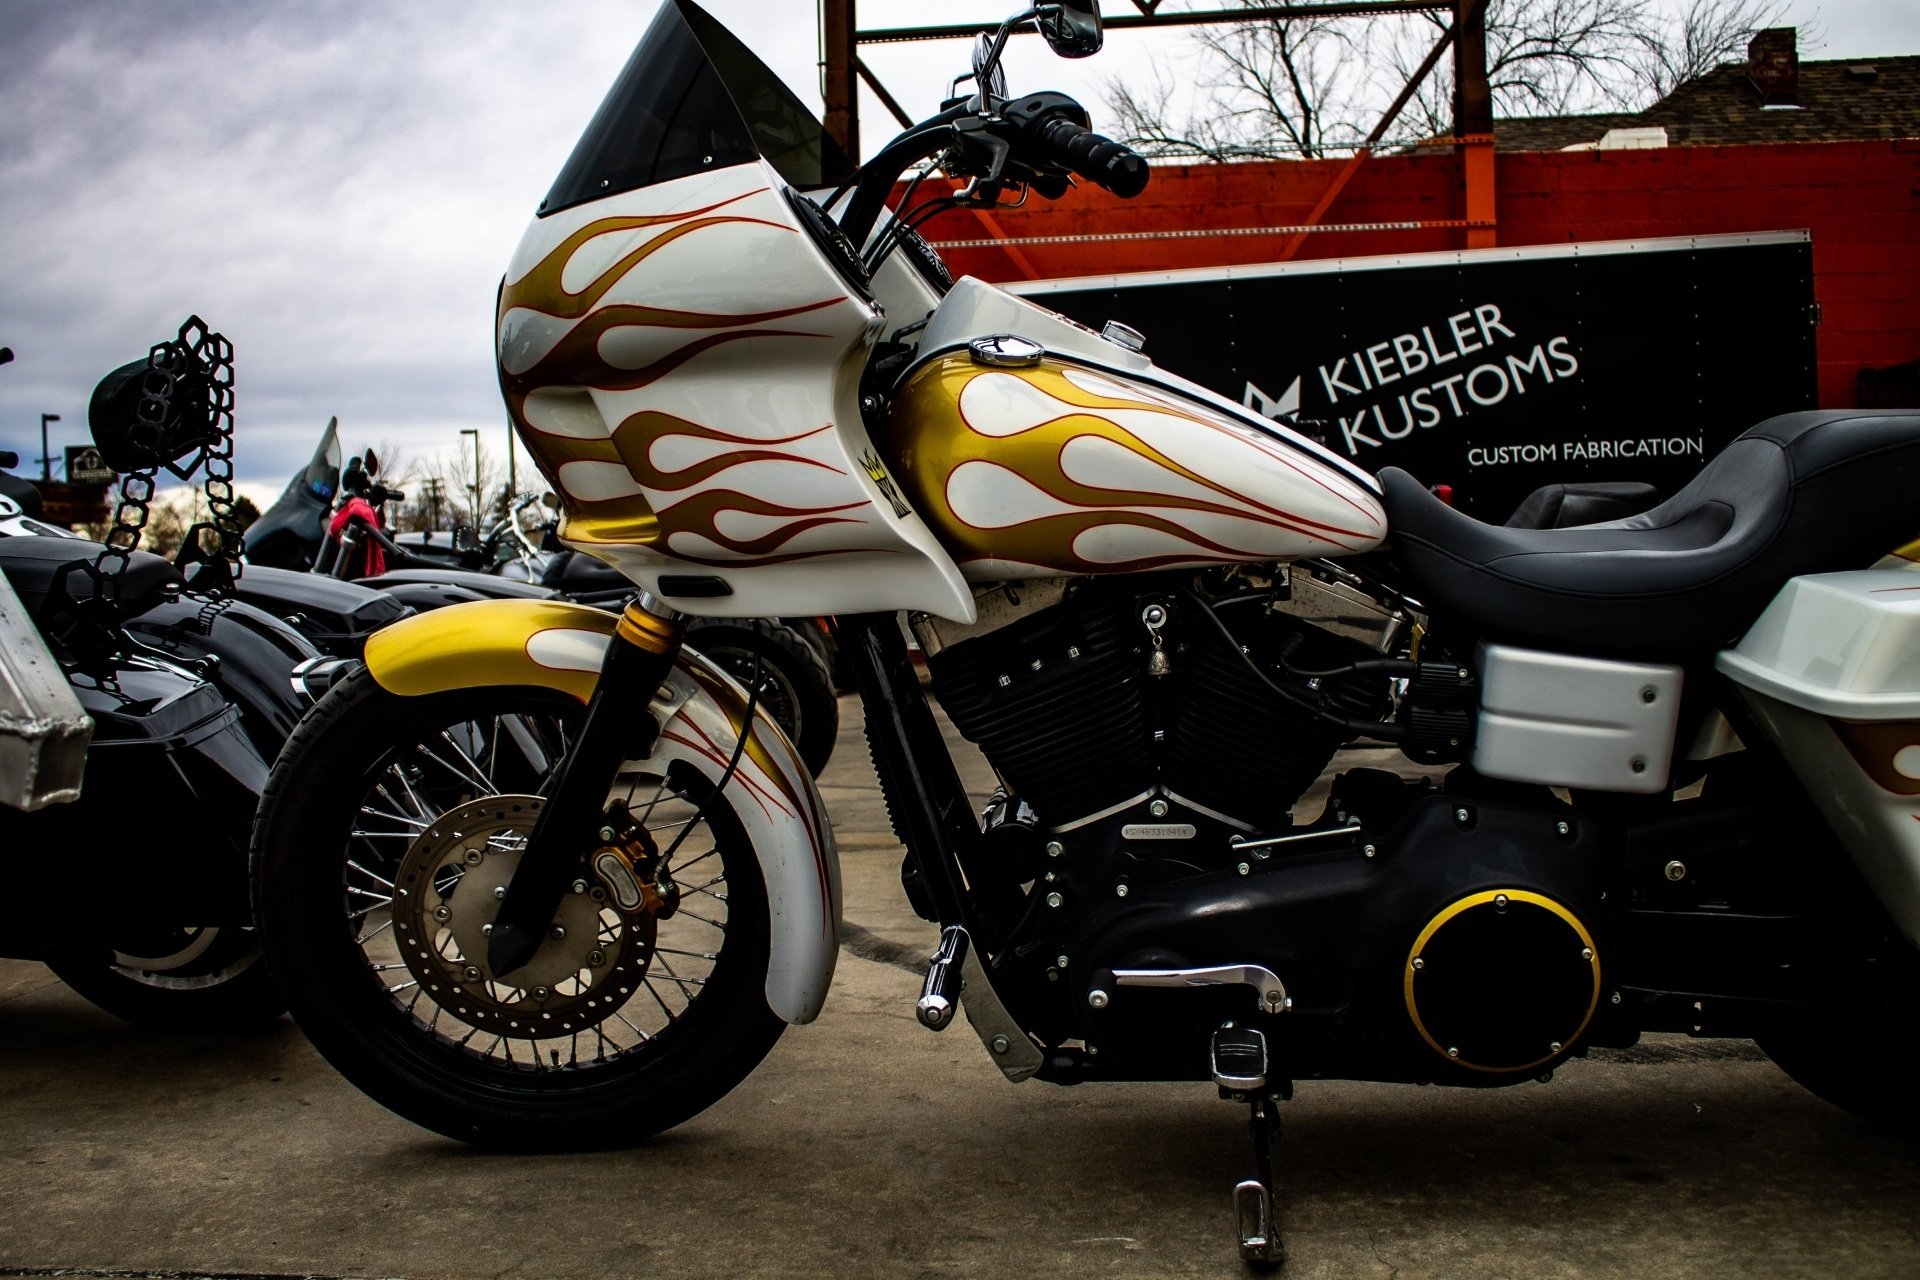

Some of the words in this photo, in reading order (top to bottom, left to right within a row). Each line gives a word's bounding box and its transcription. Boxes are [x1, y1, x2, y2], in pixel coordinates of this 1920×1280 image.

[1318, 304, 1516, 403] KIEBLER
[1338, 336, 1578, 456] KUSTOMS
[1467, 443, 1557, 466] CUSTOM
[1563, 437, 1704, 460] FABRICATION
